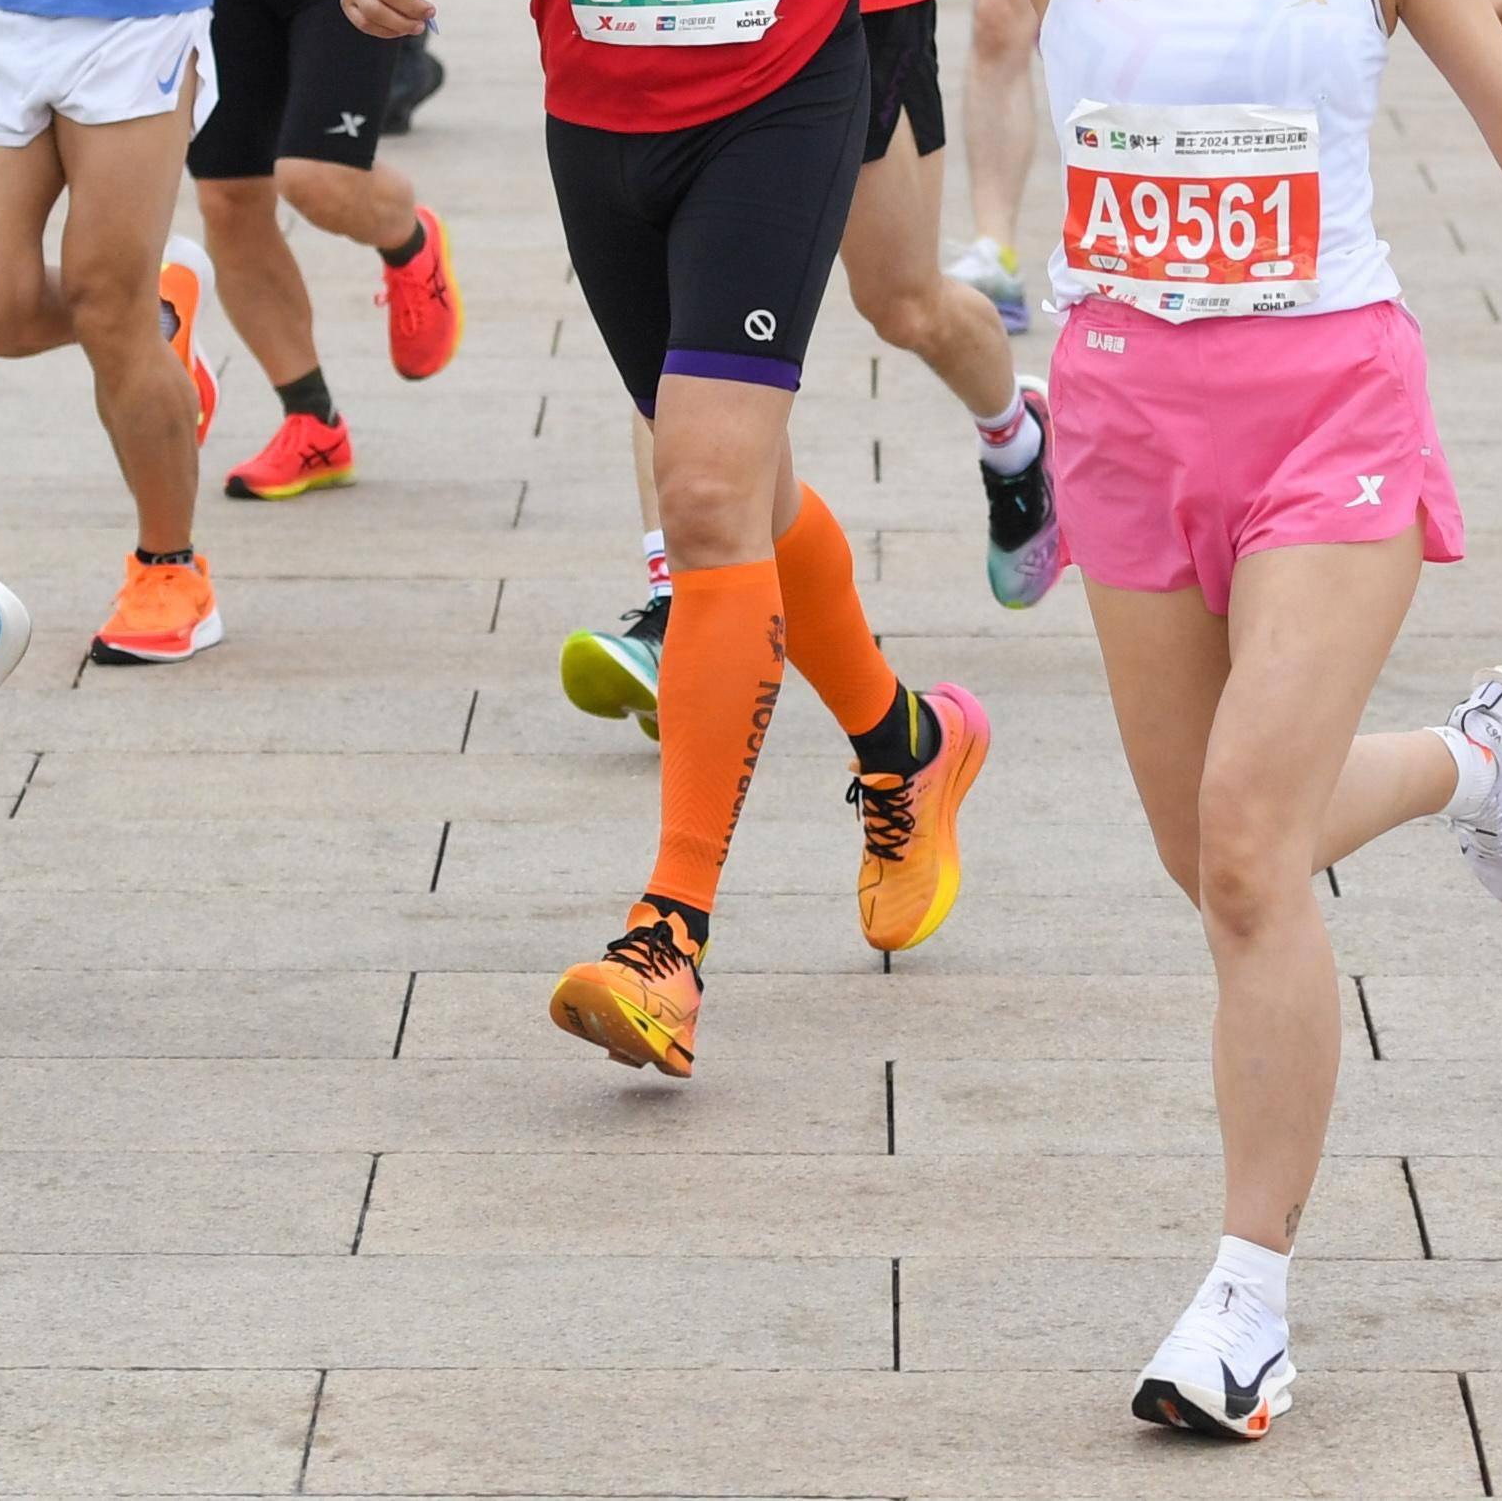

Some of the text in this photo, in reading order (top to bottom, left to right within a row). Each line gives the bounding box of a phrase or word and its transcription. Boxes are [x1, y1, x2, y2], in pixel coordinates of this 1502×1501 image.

[736, 17, 772, 29] KOHLE
[1199, 136, 1229, 147] 2024
[1079, 176, 1291, 261] A9561
